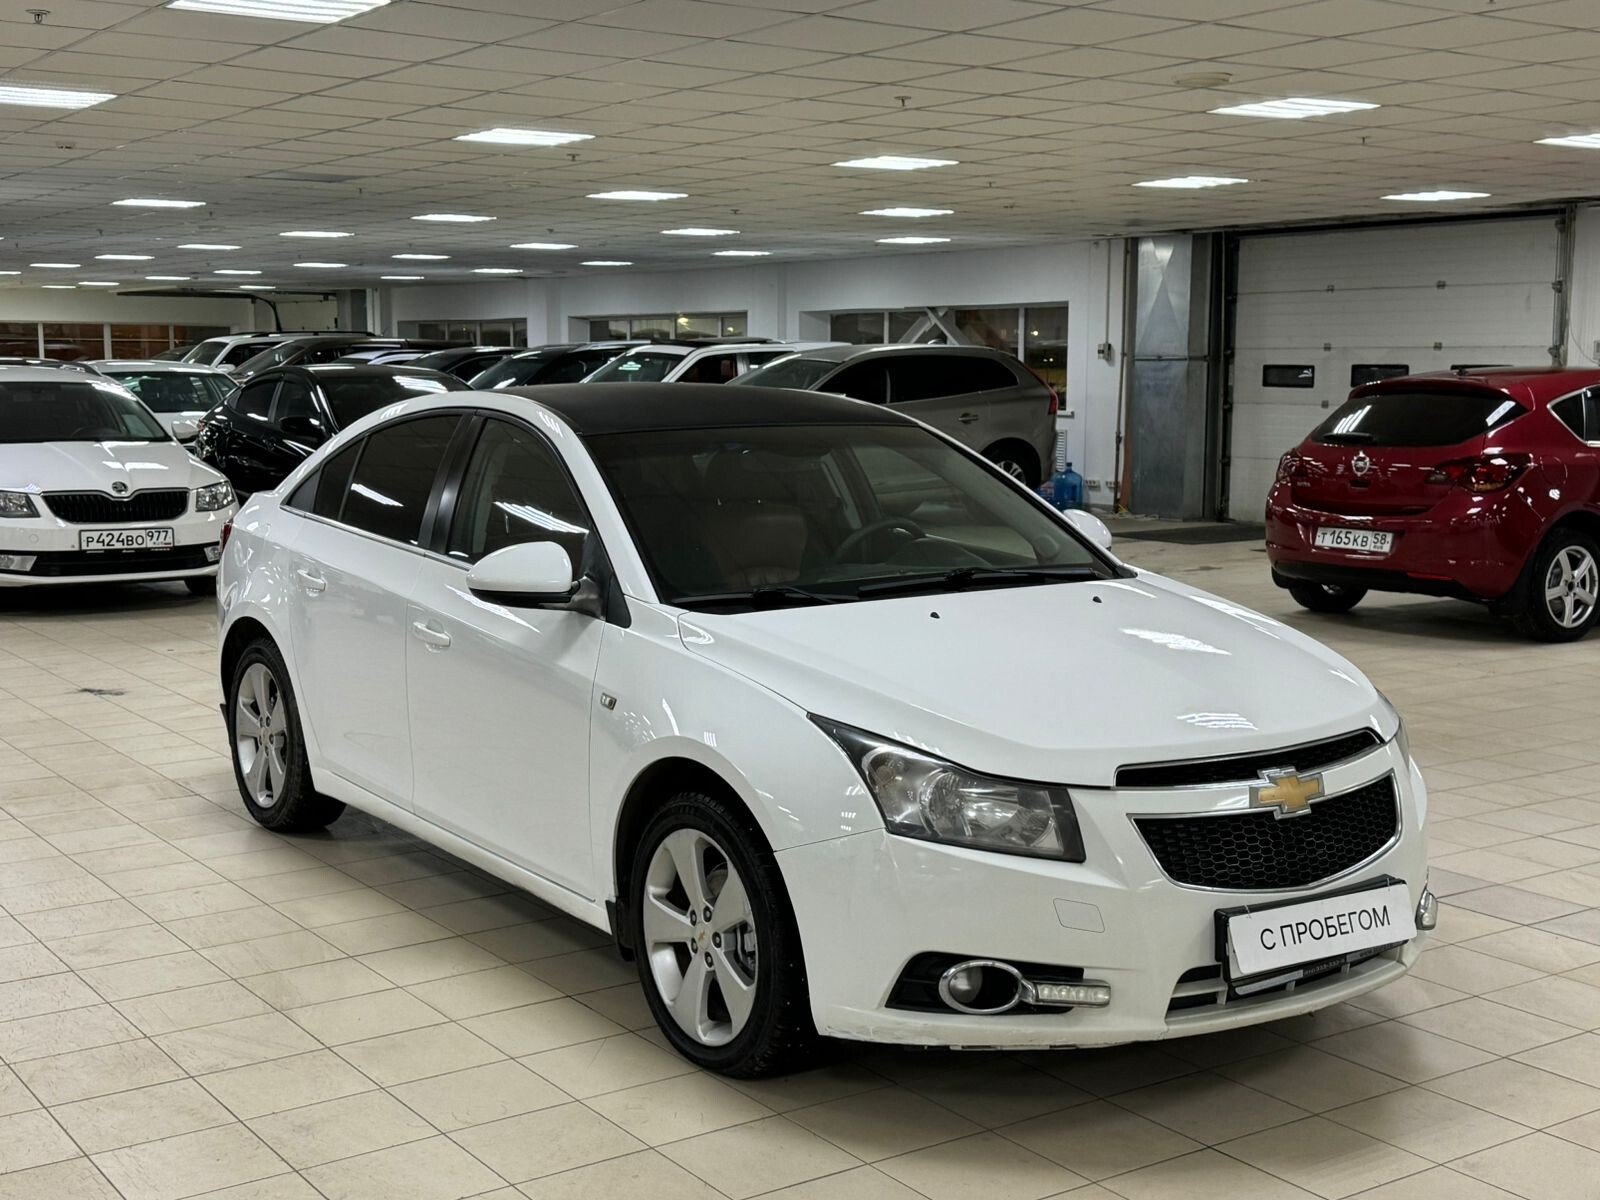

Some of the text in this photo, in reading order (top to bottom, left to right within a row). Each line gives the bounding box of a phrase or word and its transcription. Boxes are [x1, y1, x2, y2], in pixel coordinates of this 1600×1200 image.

[147, 530, 169, 541] 977
[1373, 533, 1387, 544] 58
[1260, 905, 1391, 950] С ПРОБЕГОМ
